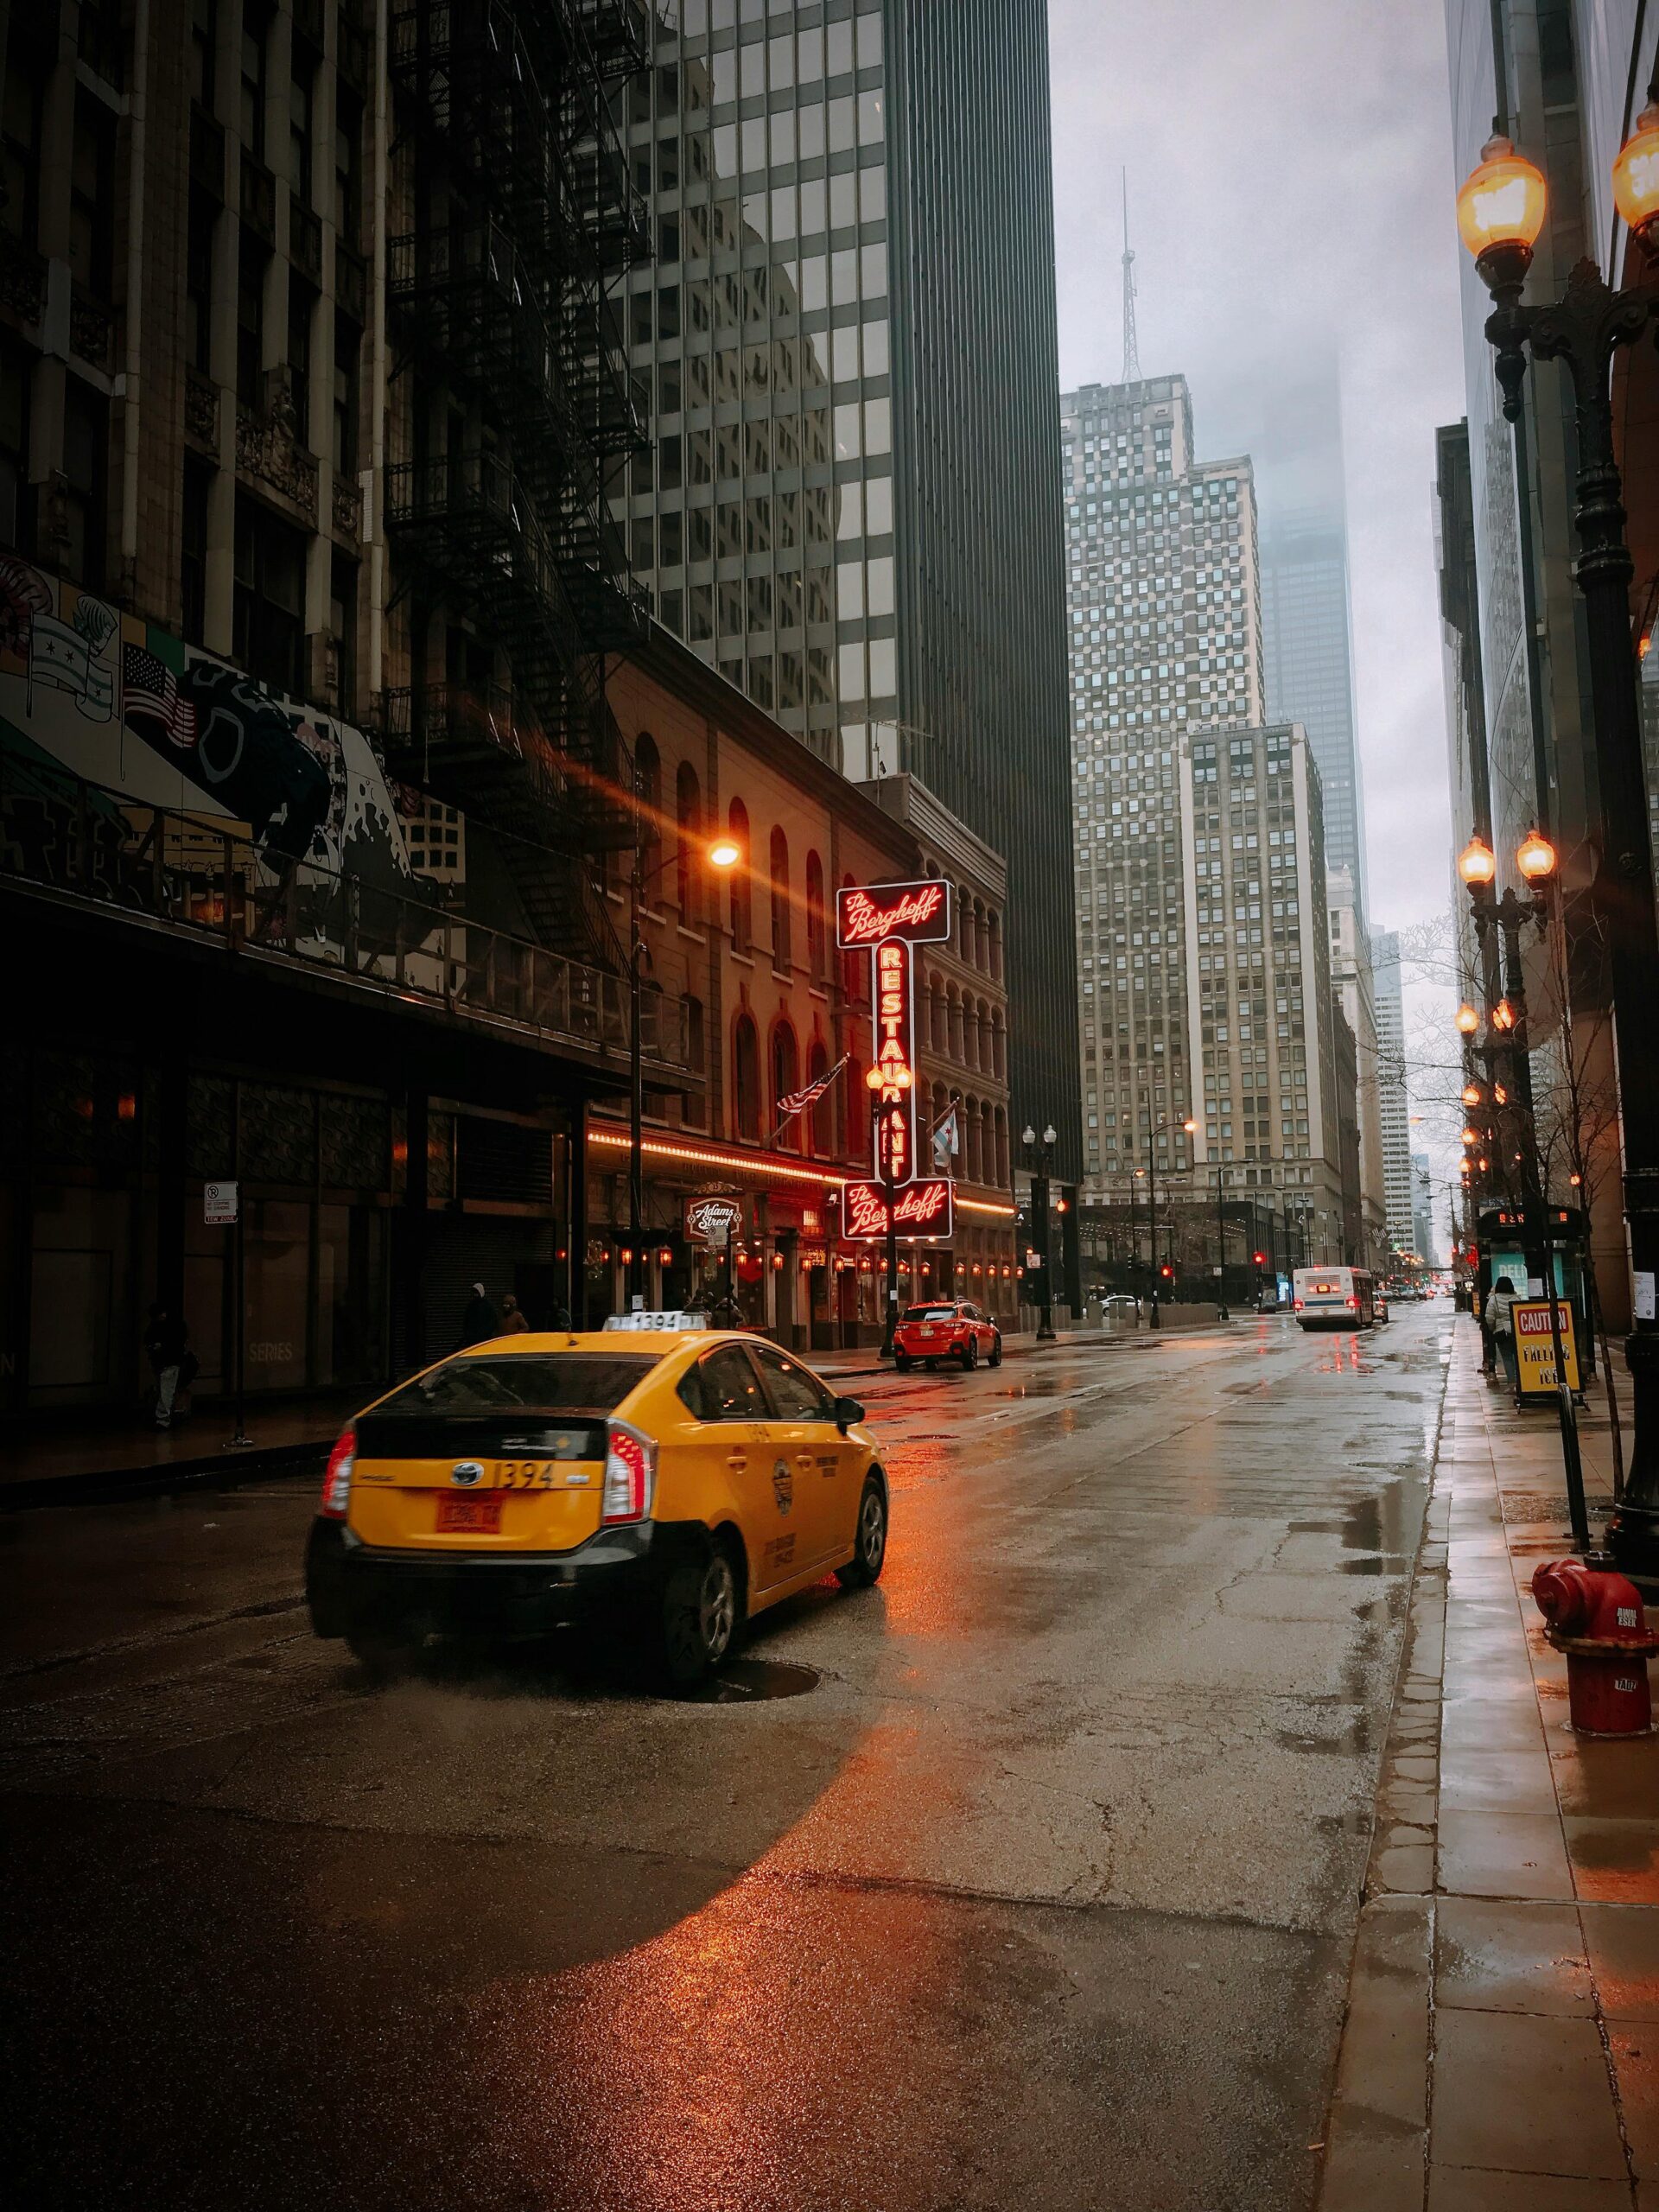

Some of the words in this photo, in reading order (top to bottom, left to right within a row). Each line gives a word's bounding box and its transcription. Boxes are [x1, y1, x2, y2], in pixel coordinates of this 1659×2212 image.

[846, 893, 869, 912] The
[845, 887, 942, 942] Berghoff
[880, 947, 907, 1177] RESTAURANT
[849, 1185, 874, 1205] The
[695, 1204, 734, 1219] Adams
[697, 1215, 732, 1230] Street
[1520, 1311, 1567, 1332] CAUTIN
[249, 1341, 293, 1363] SERIES
[1523, 1343, 1571, 1363] FALLIG
[1539, 1367, 1559, 1385] ICE
[493, 1462, 553, 1489] 1394
